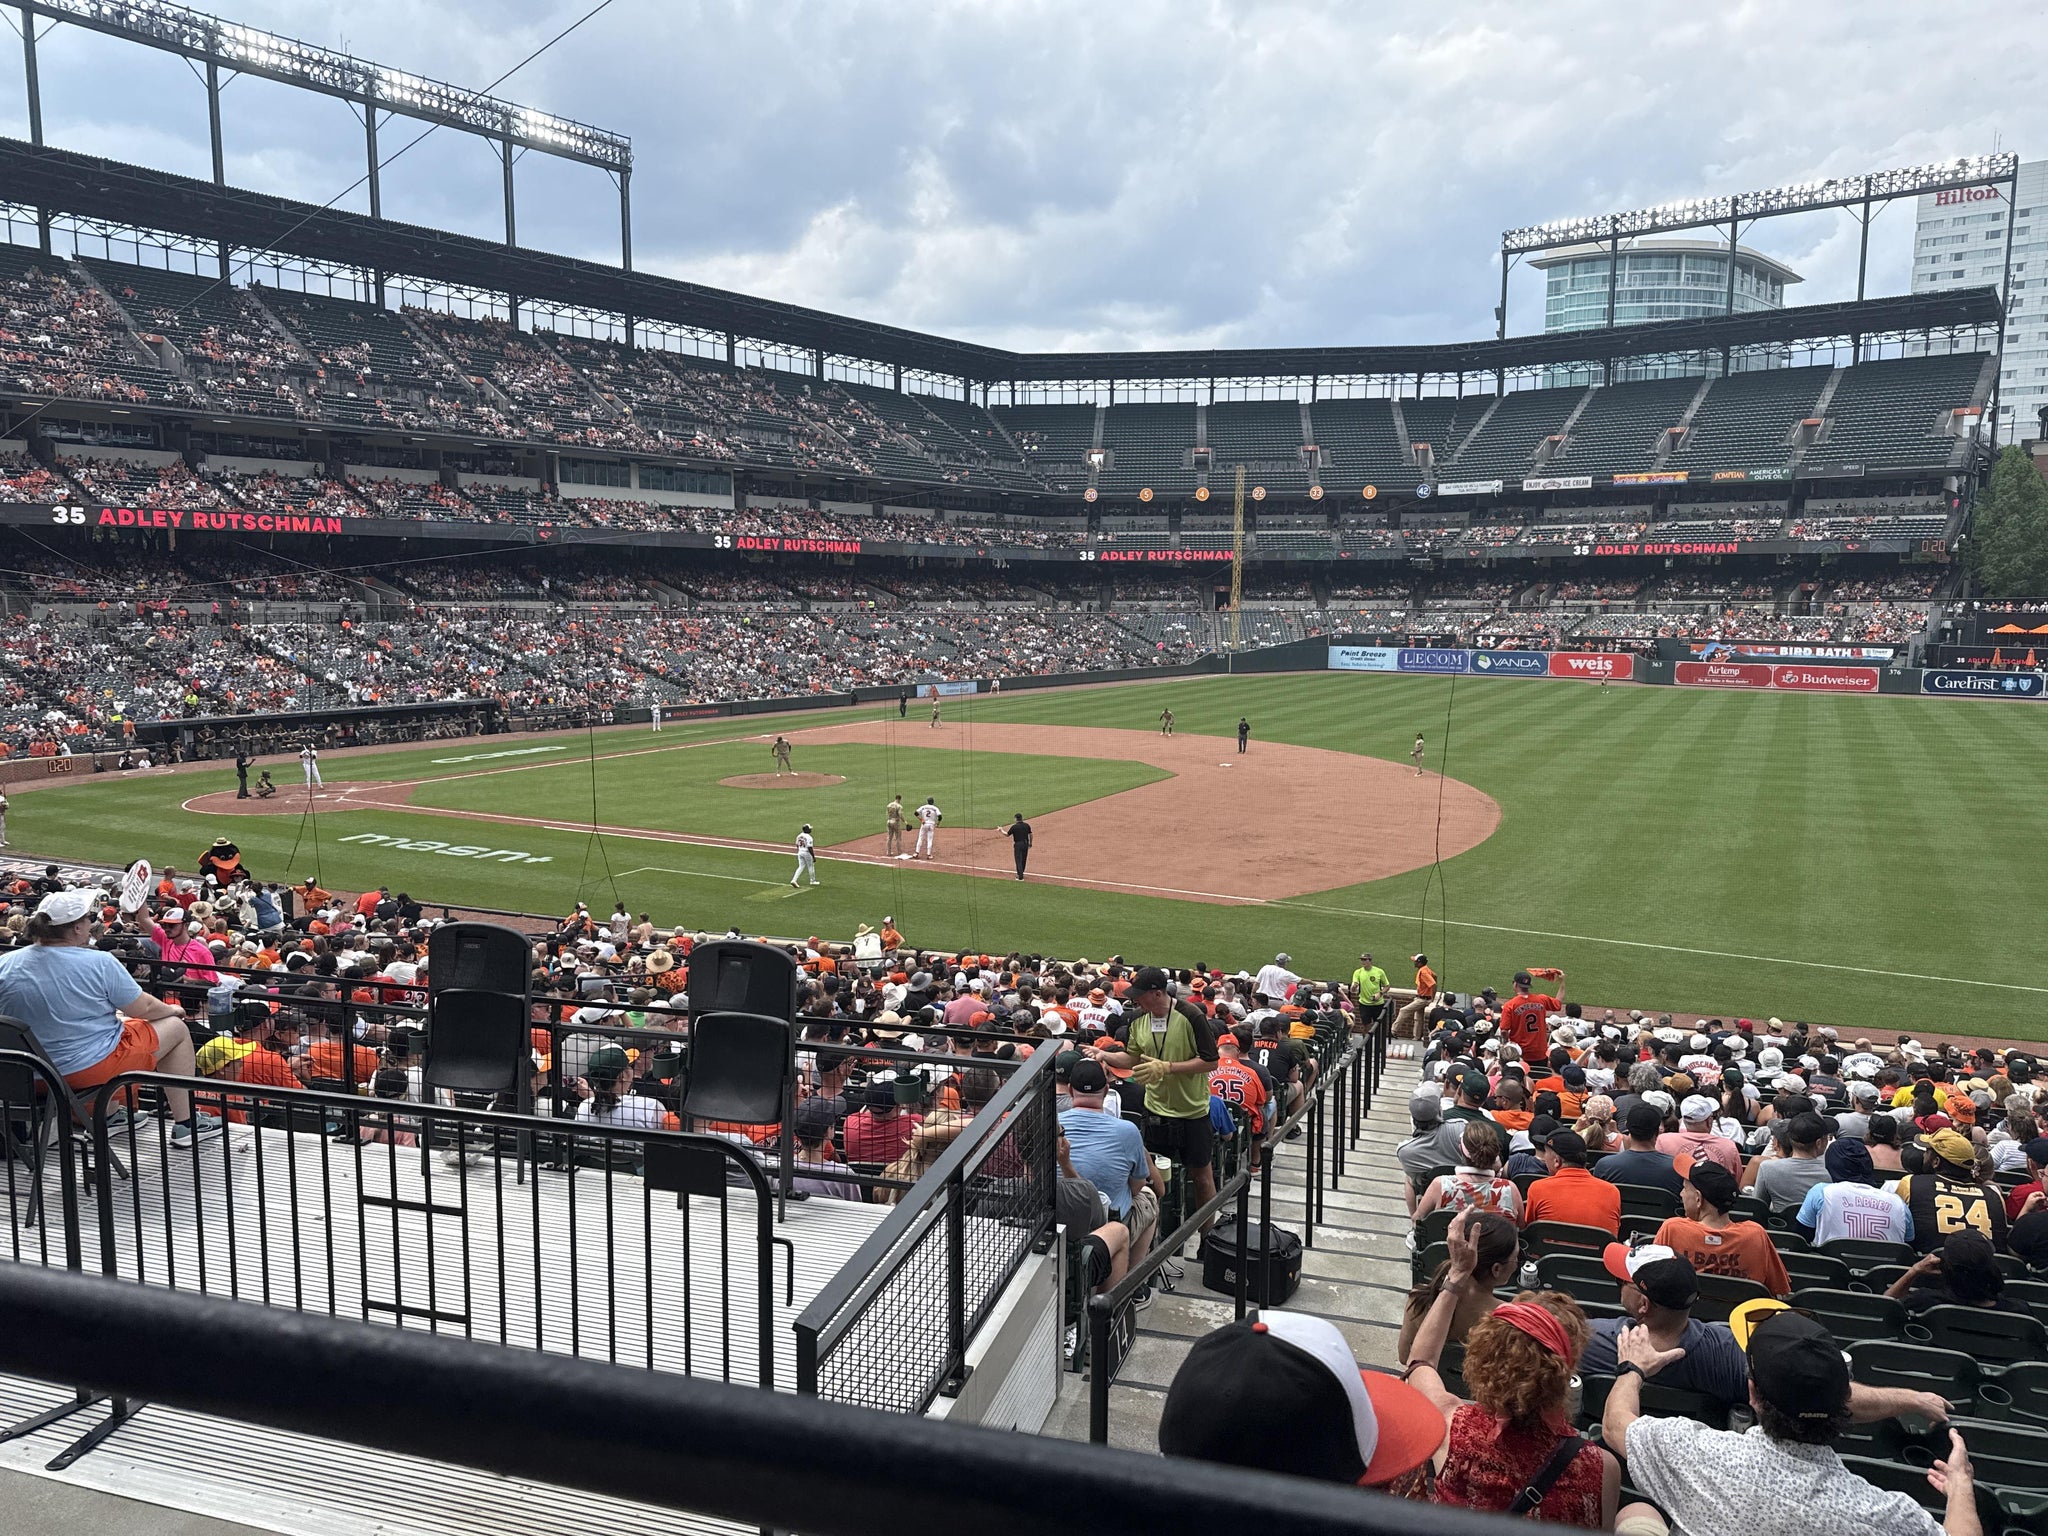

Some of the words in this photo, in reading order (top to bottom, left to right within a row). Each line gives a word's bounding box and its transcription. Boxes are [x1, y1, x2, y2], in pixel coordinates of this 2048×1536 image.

[1935, 188, 1999, 206] Hilton
[52, 505, 86, 524] 35
[98, 508, 184, 528] ADLEY
[193, 511, 342, 533] RUTSCHMAN
[714, 536, 731, 548] 35
[736, 537, 780, 550] ADLEY
[784, 539, 861, 553] RUTSCHMAN
[1573, 545, 1590, 556] 35
[1595, 545, 1640, 555] ADLEY
[1644, 543, 1738, 555] RUTSCHMAN
[1079, 551, 1095, 561] 35
[1100, 551, 1144, 561] ADLEY
[1147, 551, 1234, 561] RUTSCHMAN
[1404, 653, 1463, 665] LECOM
[1780, 647, 1812, 655] BIRD
[1816, 648, 1851, 656] BATH
[1491, 657, 1541, 667] VANDA
[1568, 656, 1613, 670] weis
[1708, 666, 1740, 676] Airtemp
[1802, 674, 1868, 685] Budweiser
[1934, 675, 1999, 690] CareFirst
[1525, 1014, 1538, 1032] 2
[1254, 1041, 1278, 1049] RIPKEN
[1259, 1049, 1269, 1067] 8
[1212, 1079, 1245, 1105] 35
[1842, 1197, 1854, 1208] J.
[1855, 1196, 1892, 1213] ABREU
[1934, 1195, 1993, 1240] 24
[1844, 1211, 1890, 1241] 15
[1695, 1251, 1740, 1266] BACK
[1116, 1315, 1129, 1363] 14
